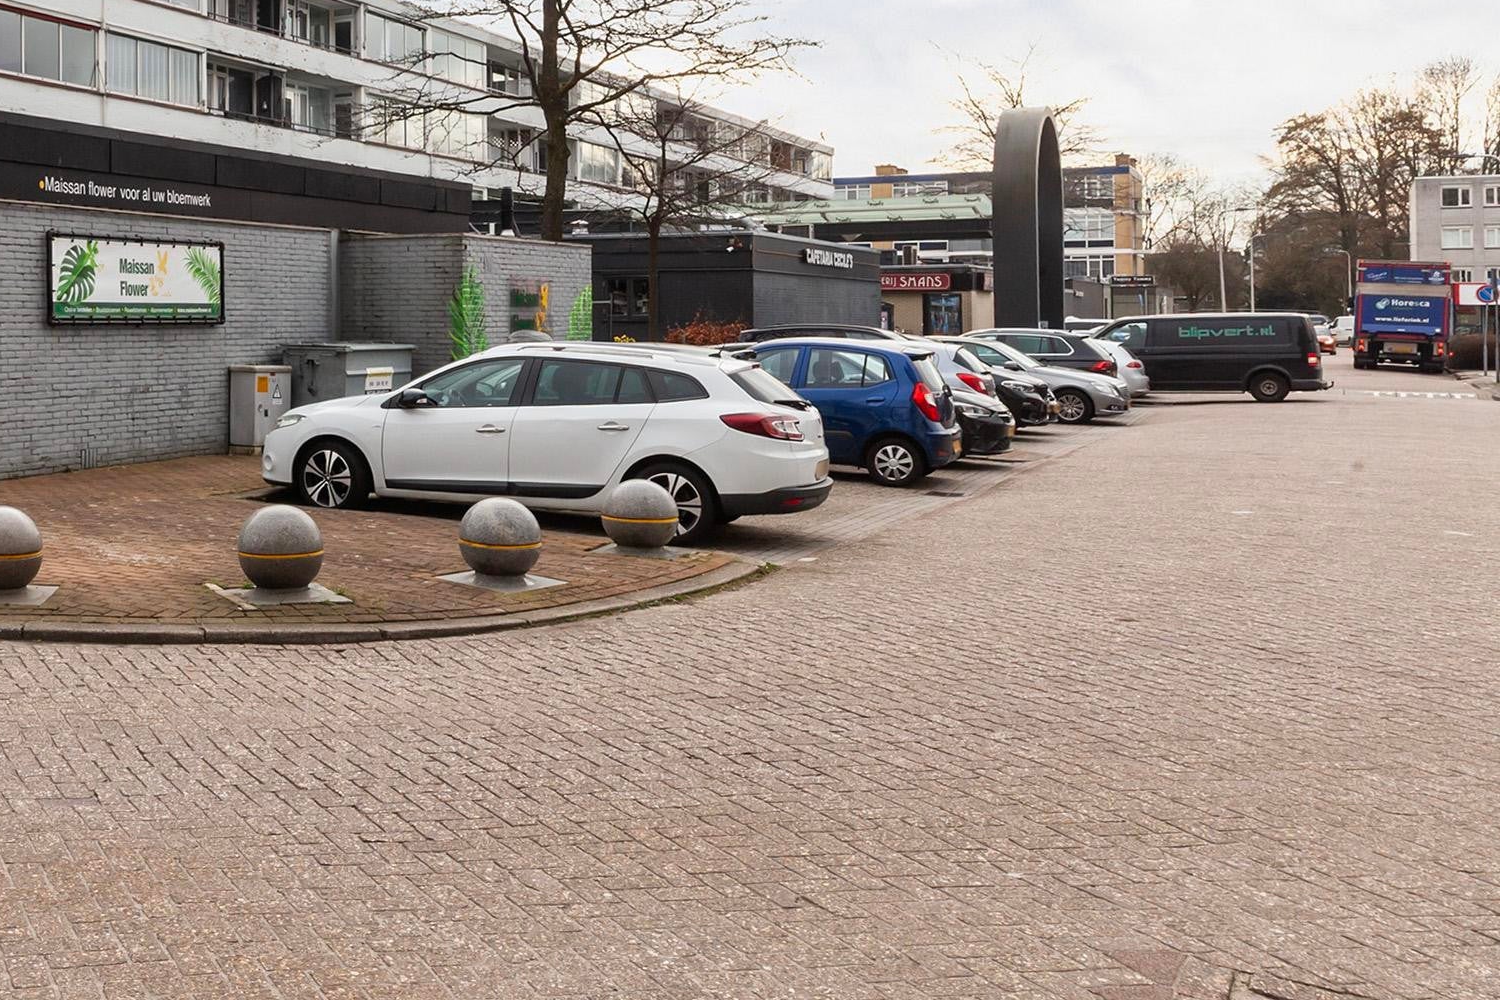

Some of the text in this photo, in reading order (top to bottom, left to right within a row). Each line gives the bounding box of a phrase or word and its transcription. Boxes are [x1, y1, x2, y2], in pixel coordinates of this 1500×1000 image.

[45, 176, 212, 207] Maissan flower voor al uw bloemwerk
[119, 258, 154, 275] Maissan
[120, 281, 148, 296] Flower
[881, 276, 942, 288] ERIJ SMANS
[1391, 299, 1430, 308] Horesca
